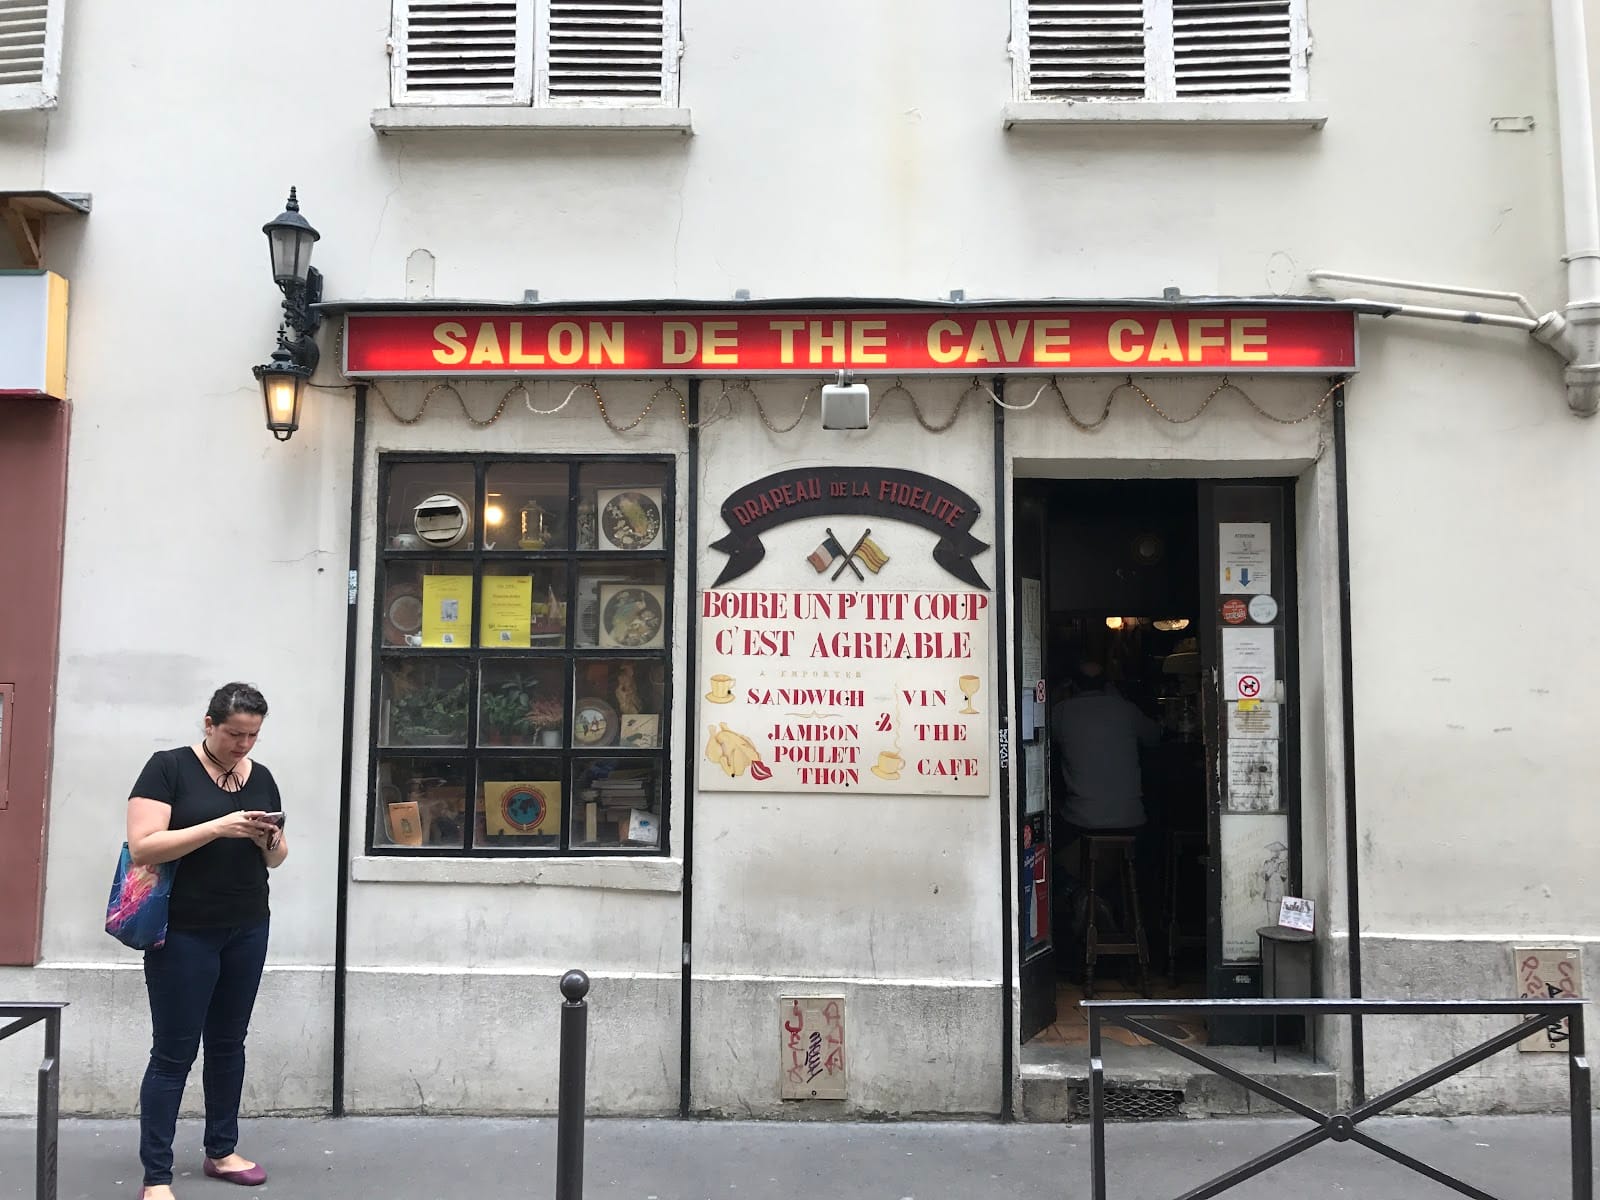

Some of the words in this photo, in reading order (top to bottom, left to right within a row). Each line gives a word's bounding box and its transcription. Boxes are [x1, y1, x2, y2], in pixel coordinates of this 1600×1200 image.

[432, 321, 625, 365] SALON
[662, 321, 738, 364] DE
[769, 320, 887, 363] THE
[927, 319, 1071, 363] CAVE
[1107, 318, 1268, 362] CAFE
[732, 477, 822, 526] DRAPEAU
[830, 481, 848, 497] DE
[851, 481, 871, 497] LA
[878, 479, 966, 528] FIDELITE
[702, 591, 788, 620] BOIRE
[793, 592, 832, 620] UN
[837, 591, 910, 622] P'TIT
[913, 593, 989, 622] COUP
[715, 626, 796, 658] C'EST
[809, 631, 973, 660] AGREABLE
[746, 687, 866, 708] SANDWICH
[902, 689, 948, 707] VIN
[767, 723, 860, 742] JAMBON
[914, 723, 968, 742] THE
[773, 745, 861, 764] POULET
[797, 767, 860, 786] THON
[916, 757, 980, 777] CAFE
